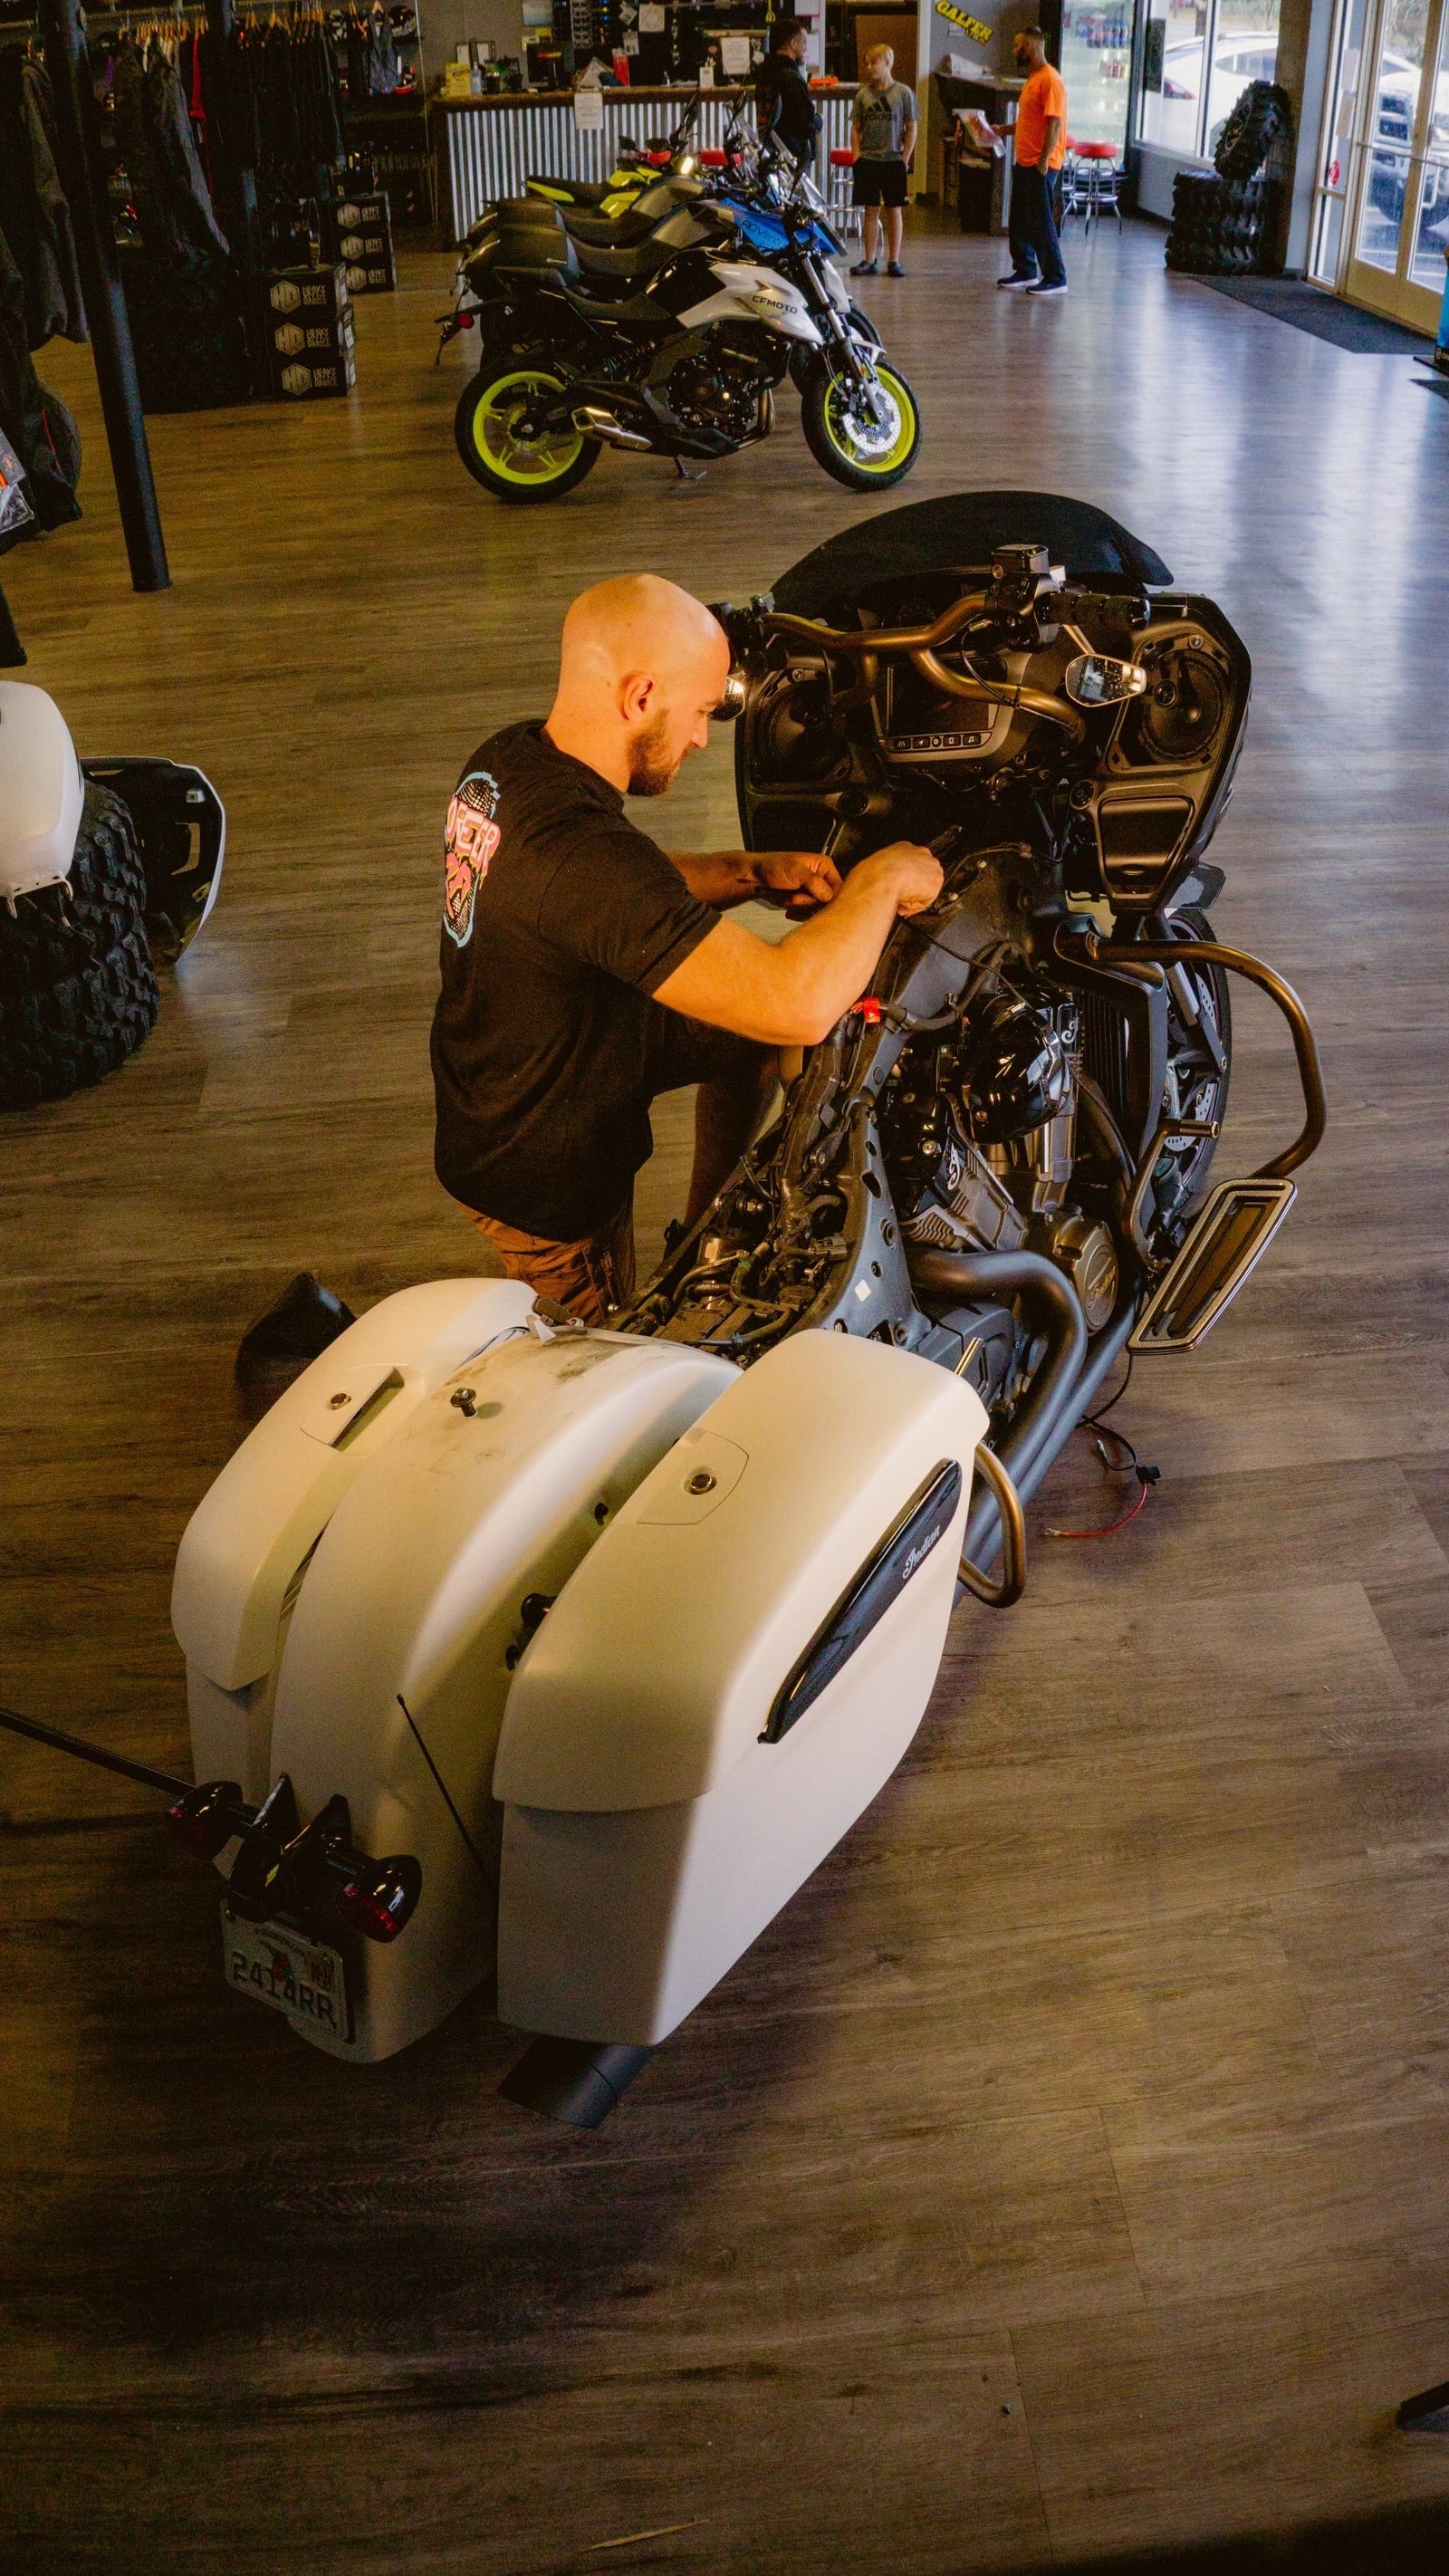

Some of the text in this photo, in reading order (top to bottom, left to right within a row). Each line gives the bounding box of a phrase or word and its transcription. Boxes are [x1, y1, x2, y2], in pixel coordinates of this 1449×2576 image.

[936, 0, 993, 43] GALFER
[752, 294, 797, 314] CFMOTO
[902, 1524, 941, 1580] Indian
